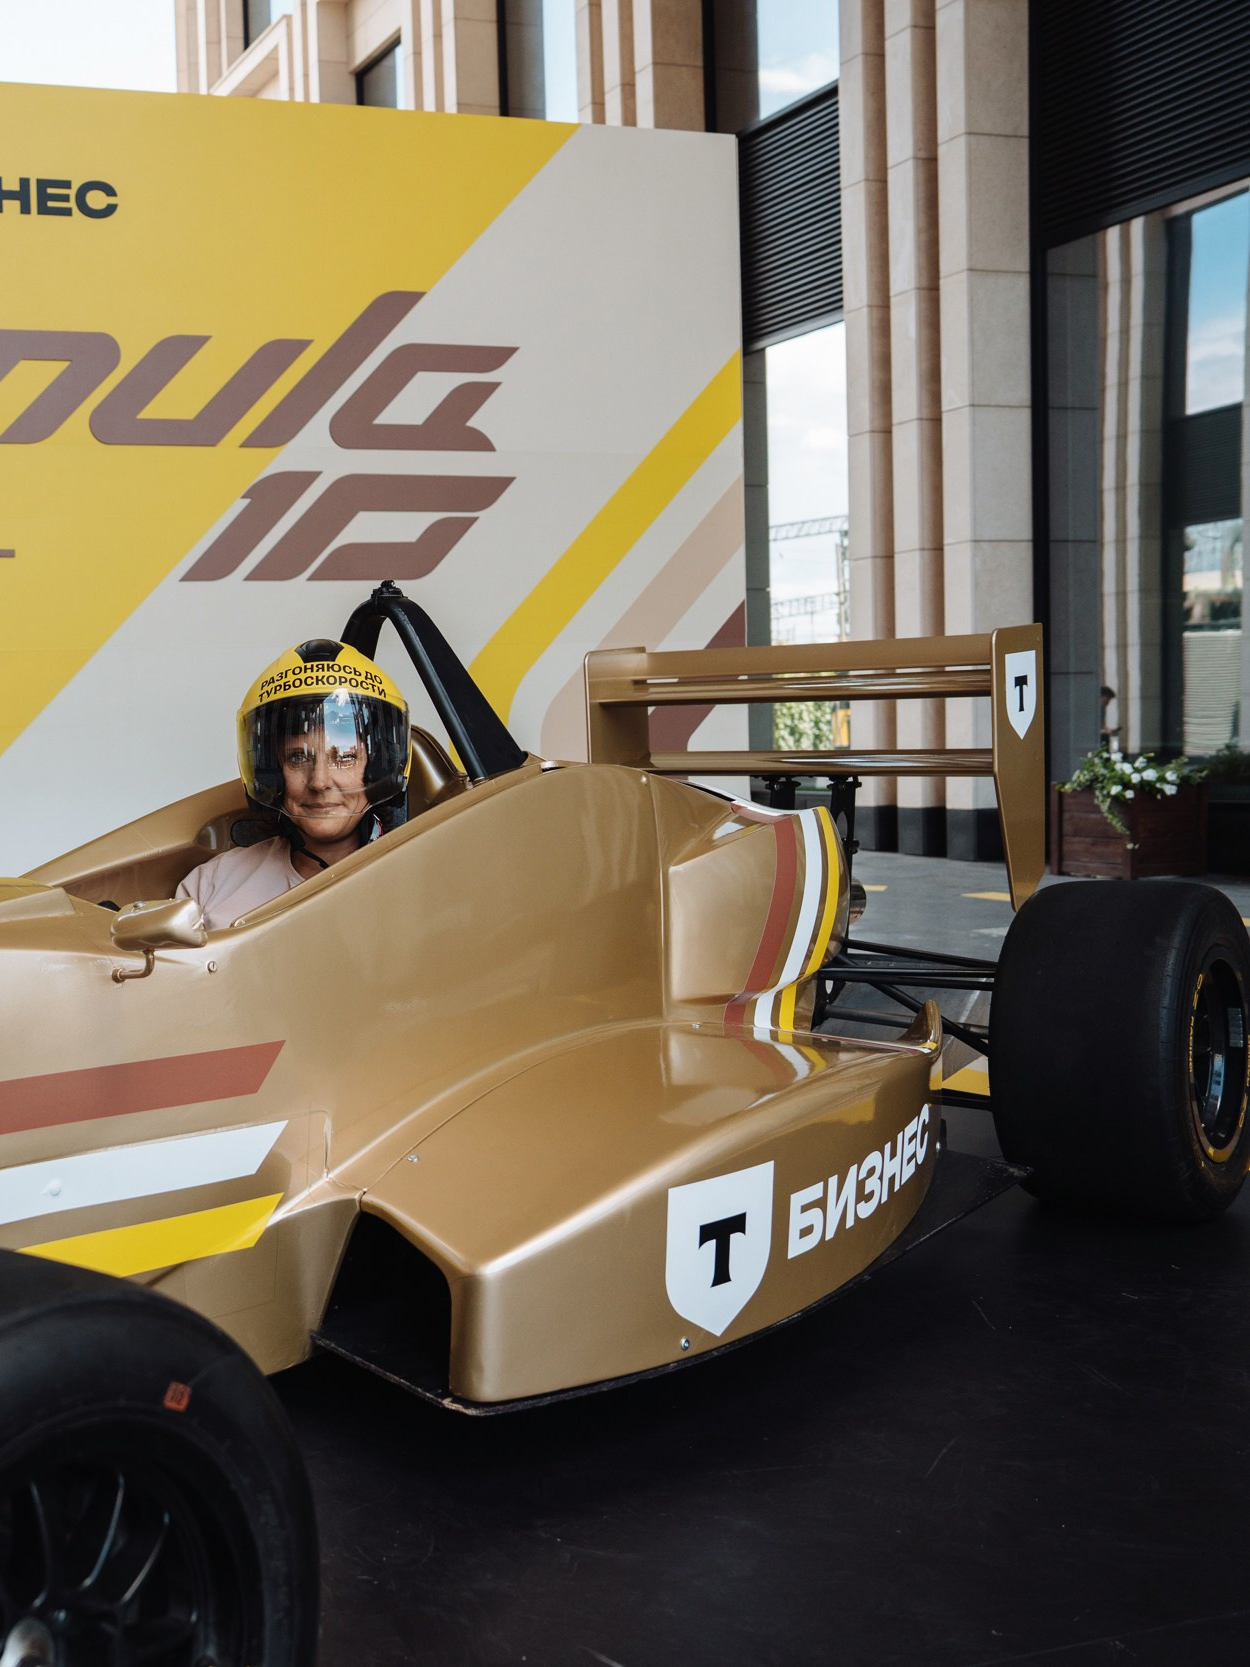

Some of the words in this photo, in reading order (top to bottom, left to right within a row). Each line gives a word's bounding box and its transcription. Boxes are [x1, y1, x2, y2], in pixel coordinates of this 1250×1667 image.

[258, 674, 387, 703] ТУРБОСКОРОСТИ
[260, 663, 362, 691] РАЗГОНЯЮСЬ
[364, 669, 383, 686] ДО
[1014, 675, 1028, 712] Т
[698, 1212, 747, 1288] Т
[788, 1103, 929, 1260] БИЗНЕС
